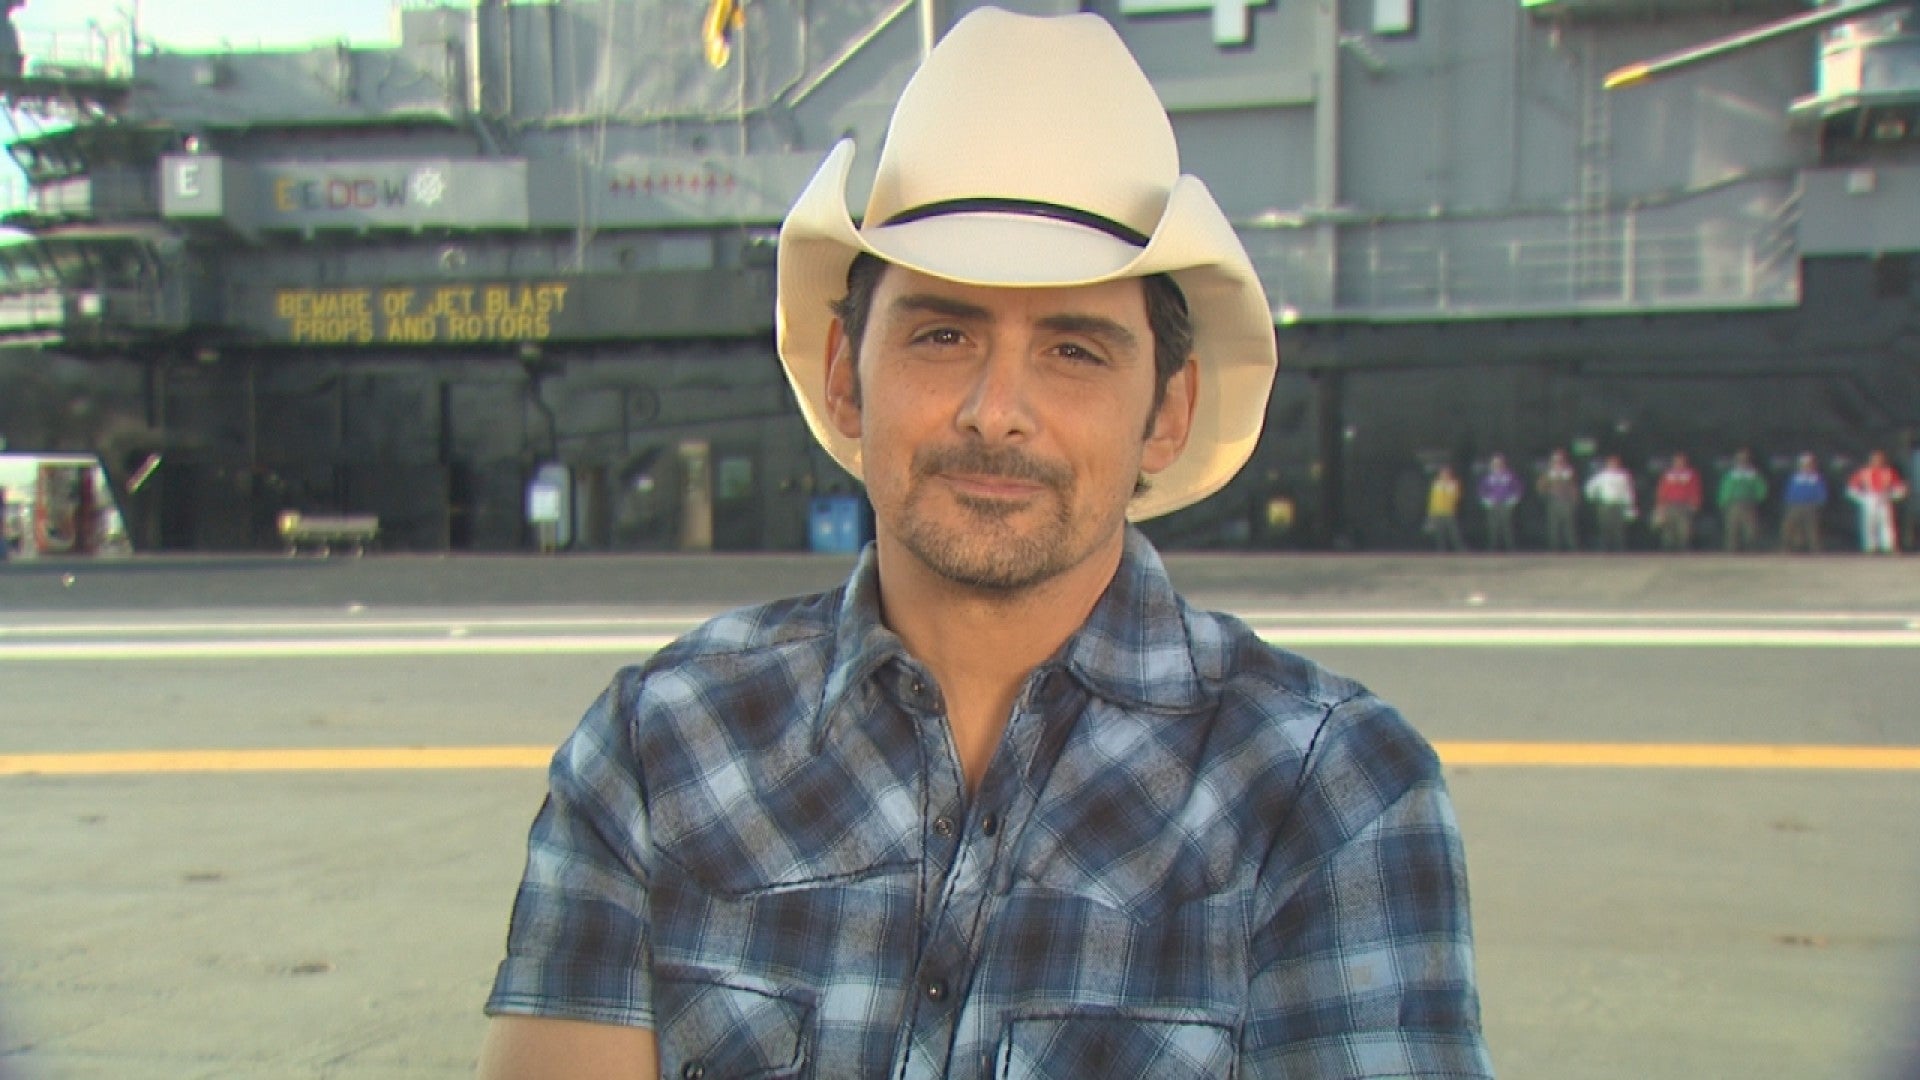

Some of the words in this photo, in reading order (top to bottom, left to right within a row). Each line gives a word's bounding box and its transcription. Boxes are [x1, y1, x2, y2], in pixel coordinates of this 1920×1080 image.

[177, 164, 200, 198] E
[278, 290, 371, 317] BEWARE
[383, 287, 415, 316] OF
[427, 285, 474, 314] JET
[485, 283, 568, 312] BLAST
[292, 316, 372, 343] PROPS
[388, 315, 435, 342] AND
[450, 313, 550, 340] ROTORS
